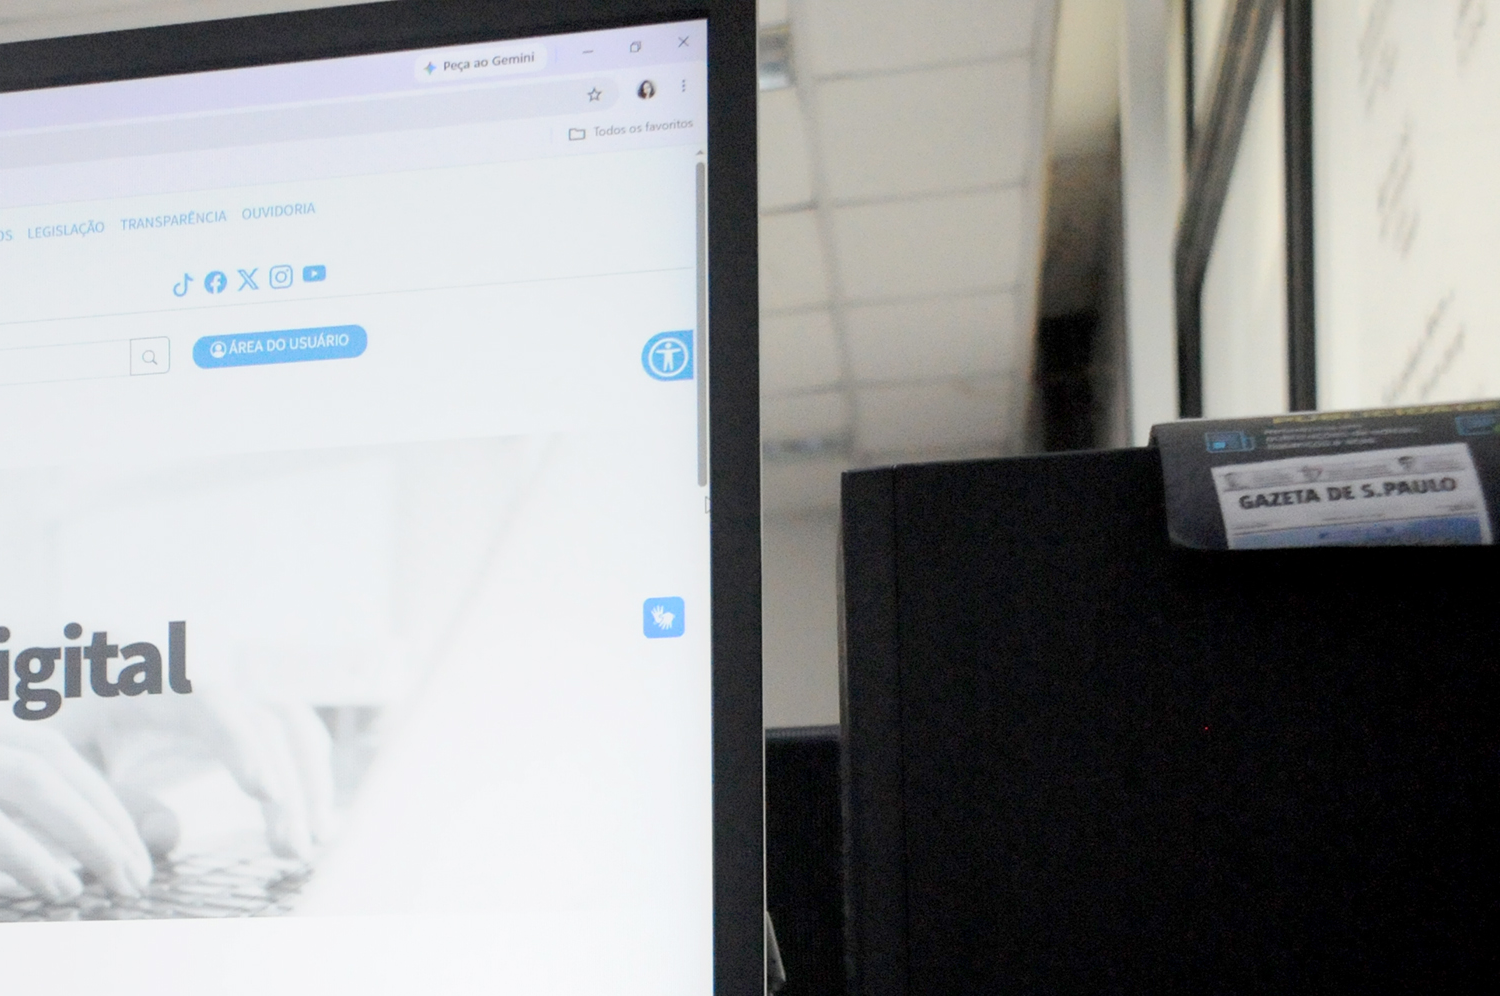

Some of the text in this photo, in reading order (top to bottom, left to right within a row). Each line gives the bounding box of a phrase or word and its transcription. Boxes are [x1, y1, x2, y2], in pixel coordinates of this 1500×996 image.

[443, 52, 535, 73] Peça ao Gemini
[594, 118, 694, 137] Todos os favoritos
[120, 210, 228, 232] TRANSPARÊNCIA
[242, 202, 316, 221] OUVIDORIA
[27, 220, 105, 240] LEGISLAÇÃO
[229, 332, 349, 355] ÁREA DO USUÁRIO
[1238, 488, 1321, 510] GAZETA
[1328, 485, 1356, 501] DE
